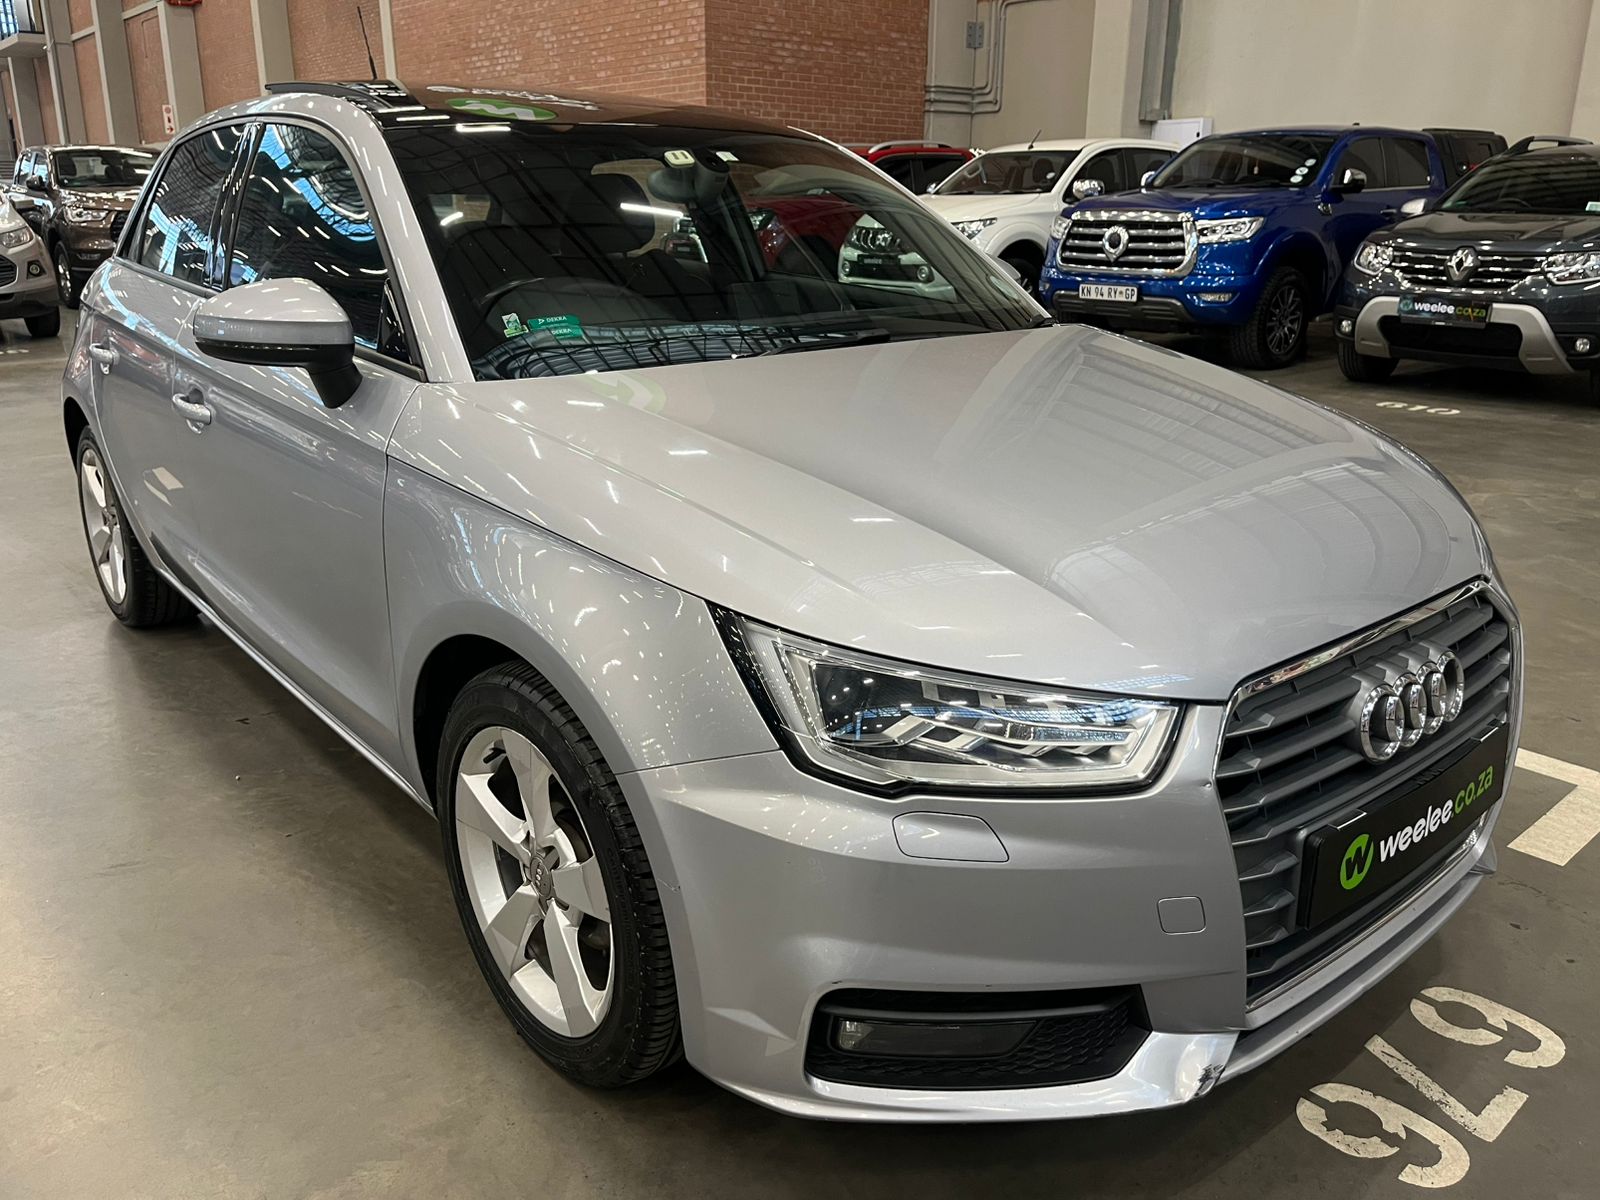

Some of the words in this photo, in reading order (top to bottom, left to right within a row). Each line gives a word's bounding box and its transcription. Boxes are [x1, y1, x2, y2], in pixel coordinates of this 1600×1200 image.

[1081, 286, 1091, 297] KN
[1094, 287, 1104, 298] 94
[1107, 287, 1118, 299] RY
[1124, 288, 1135, 300] GP
[1379, 765, 1494, 863] weelee.co.za
